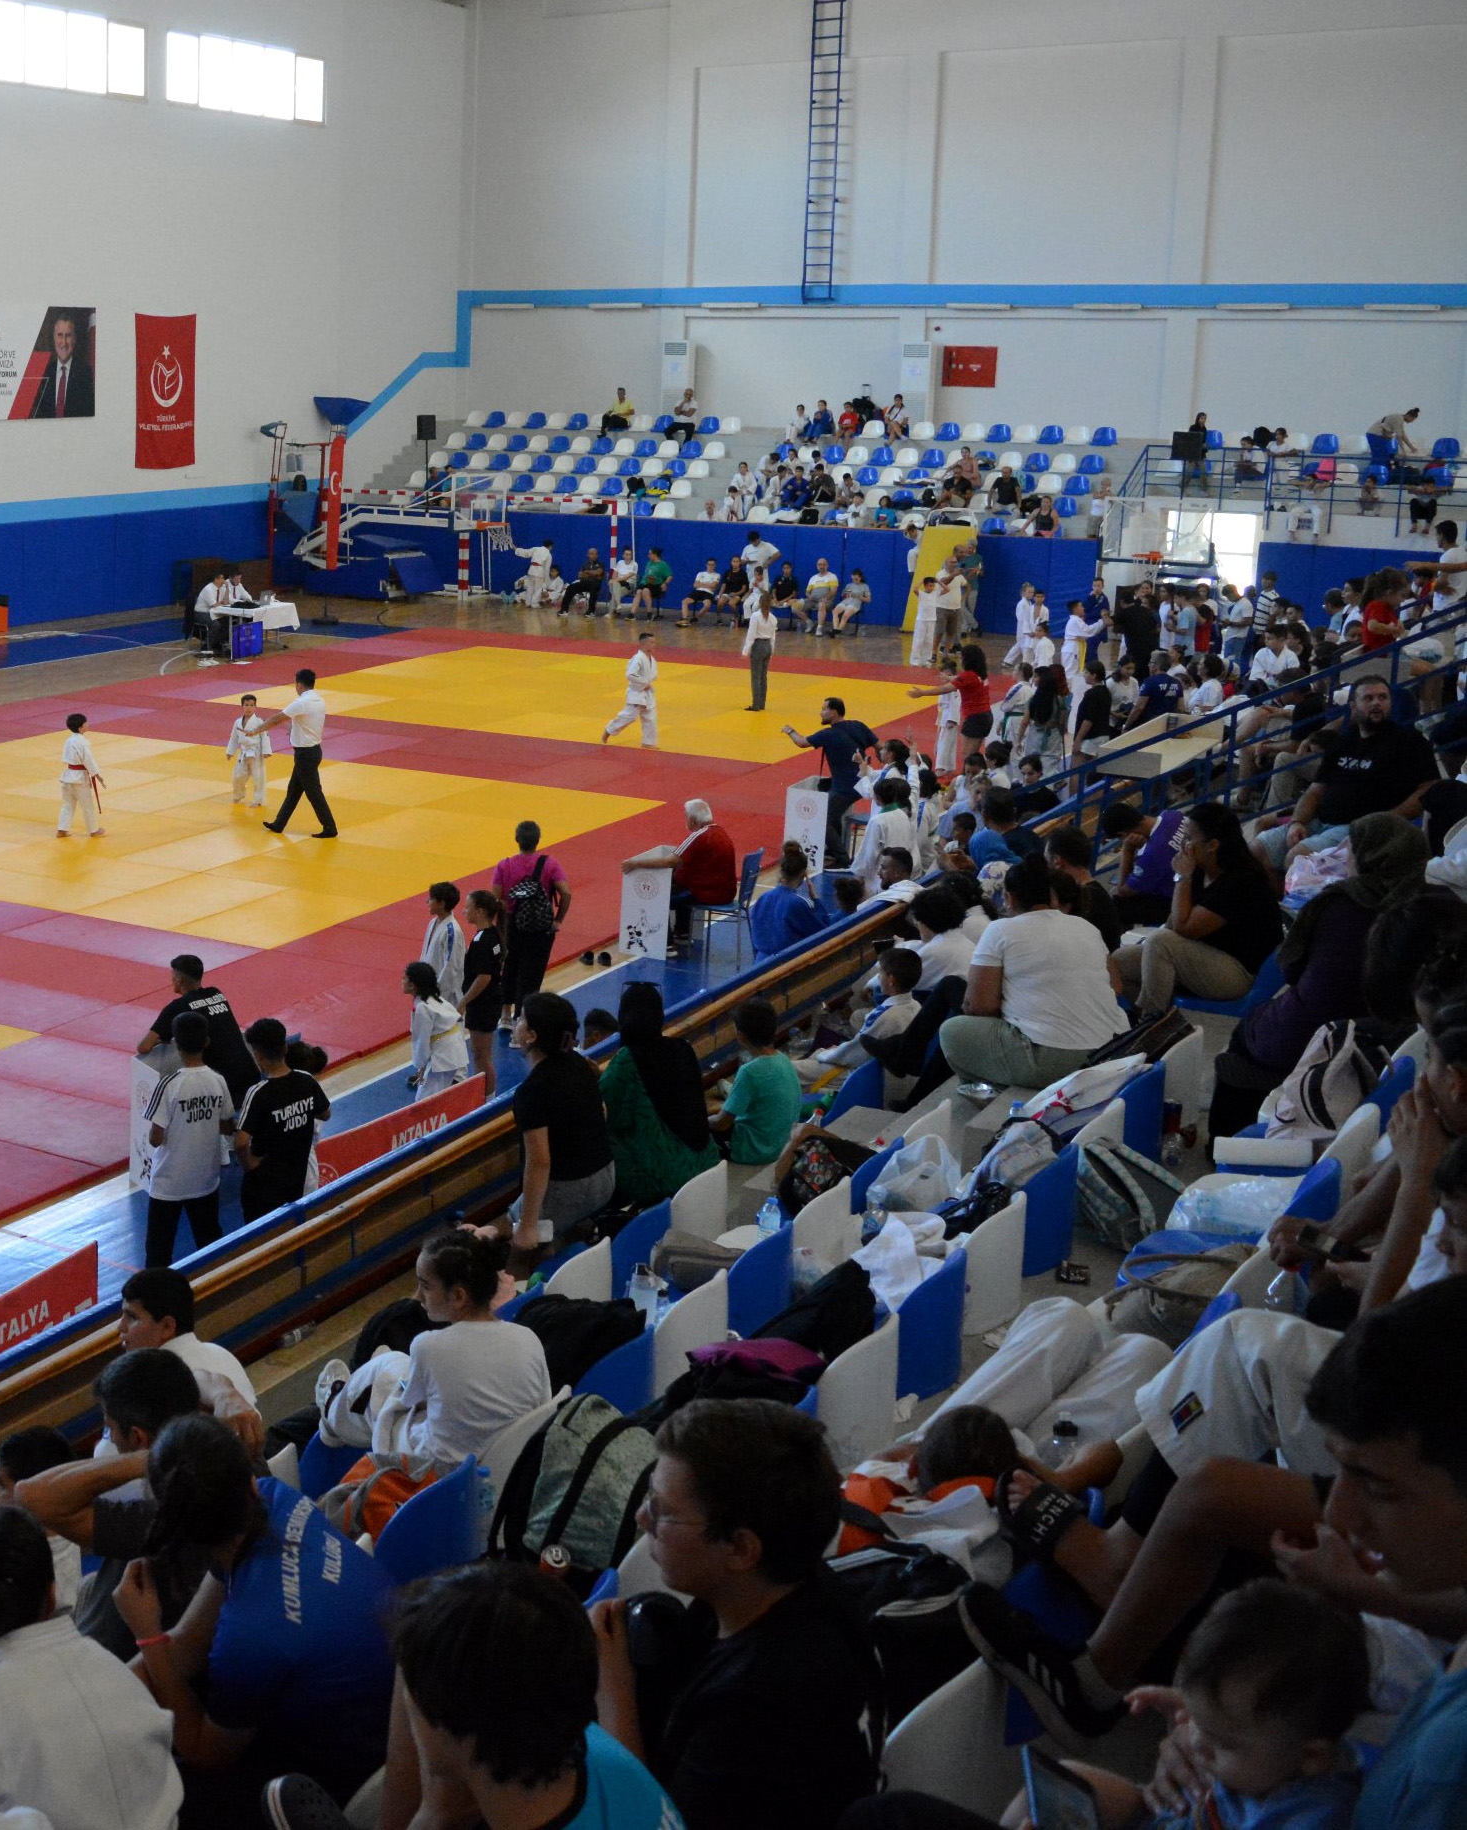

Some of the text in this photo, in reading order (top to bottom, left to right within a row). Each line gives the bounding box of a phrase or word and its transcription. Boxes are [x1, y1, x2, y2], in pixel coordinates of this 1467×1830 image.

[8, 350, 16, 359] VE
[208, 1003, 229, 1016] JUDO
[179, 1095, 222, 1113] TURKIYE
[272, 1096, 314, 1123] TURKIYE
[186, 1108, 213, 1124] JUDO
[284, 1113, 308, 1132] JUDO
[391, 1112, 448, 1151] ANTALYA
[282, 1543, 302, 1625] KUMLUCA
